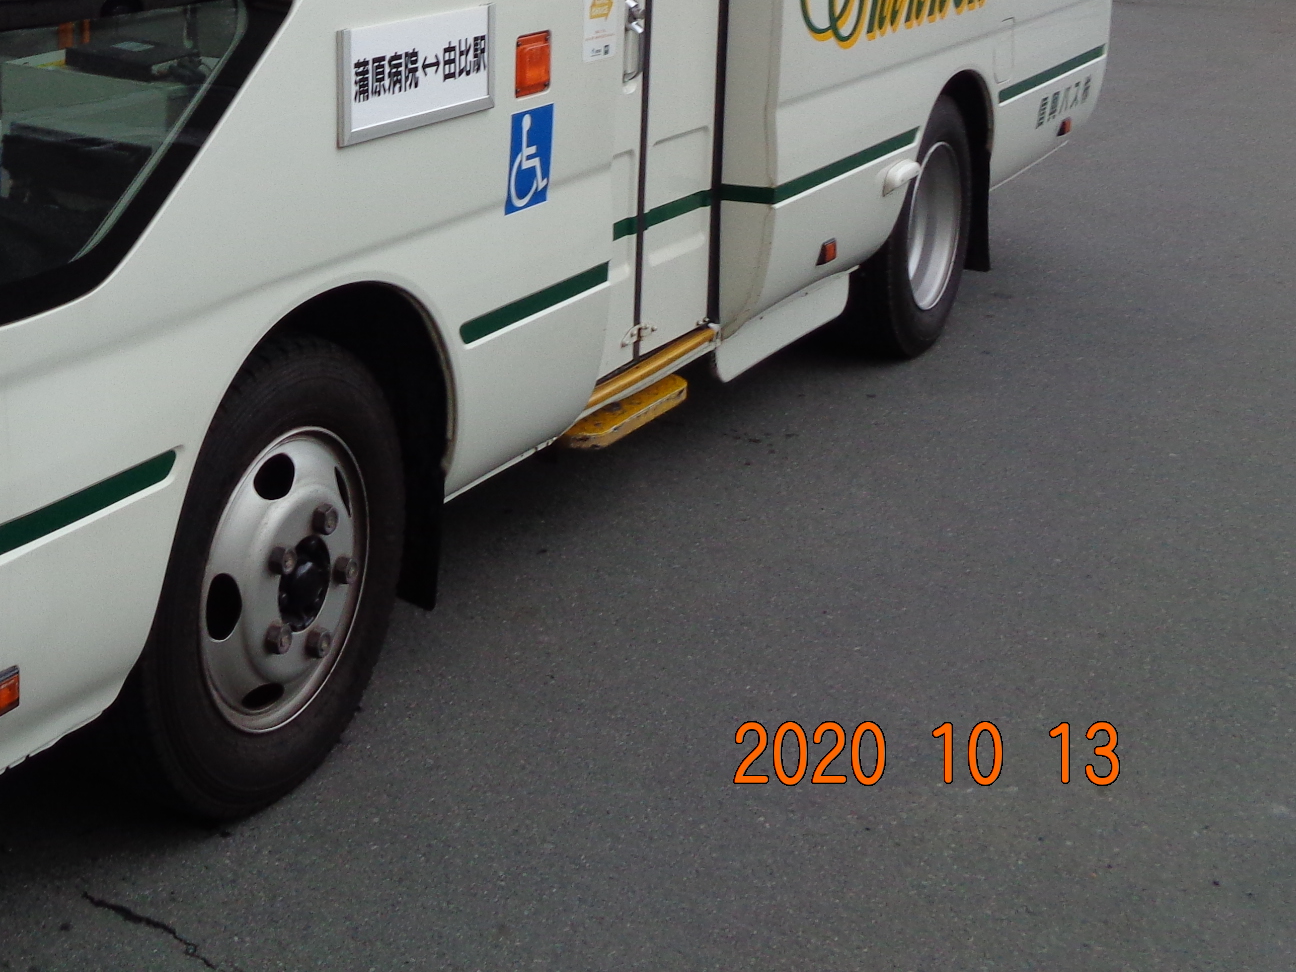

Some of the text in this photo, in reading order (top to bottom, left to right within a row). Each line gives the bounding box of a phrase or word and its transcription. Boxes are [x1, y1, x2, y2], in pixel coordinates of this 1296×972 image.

[354, 34, 487, 103] 蒲原病院 由比駅
